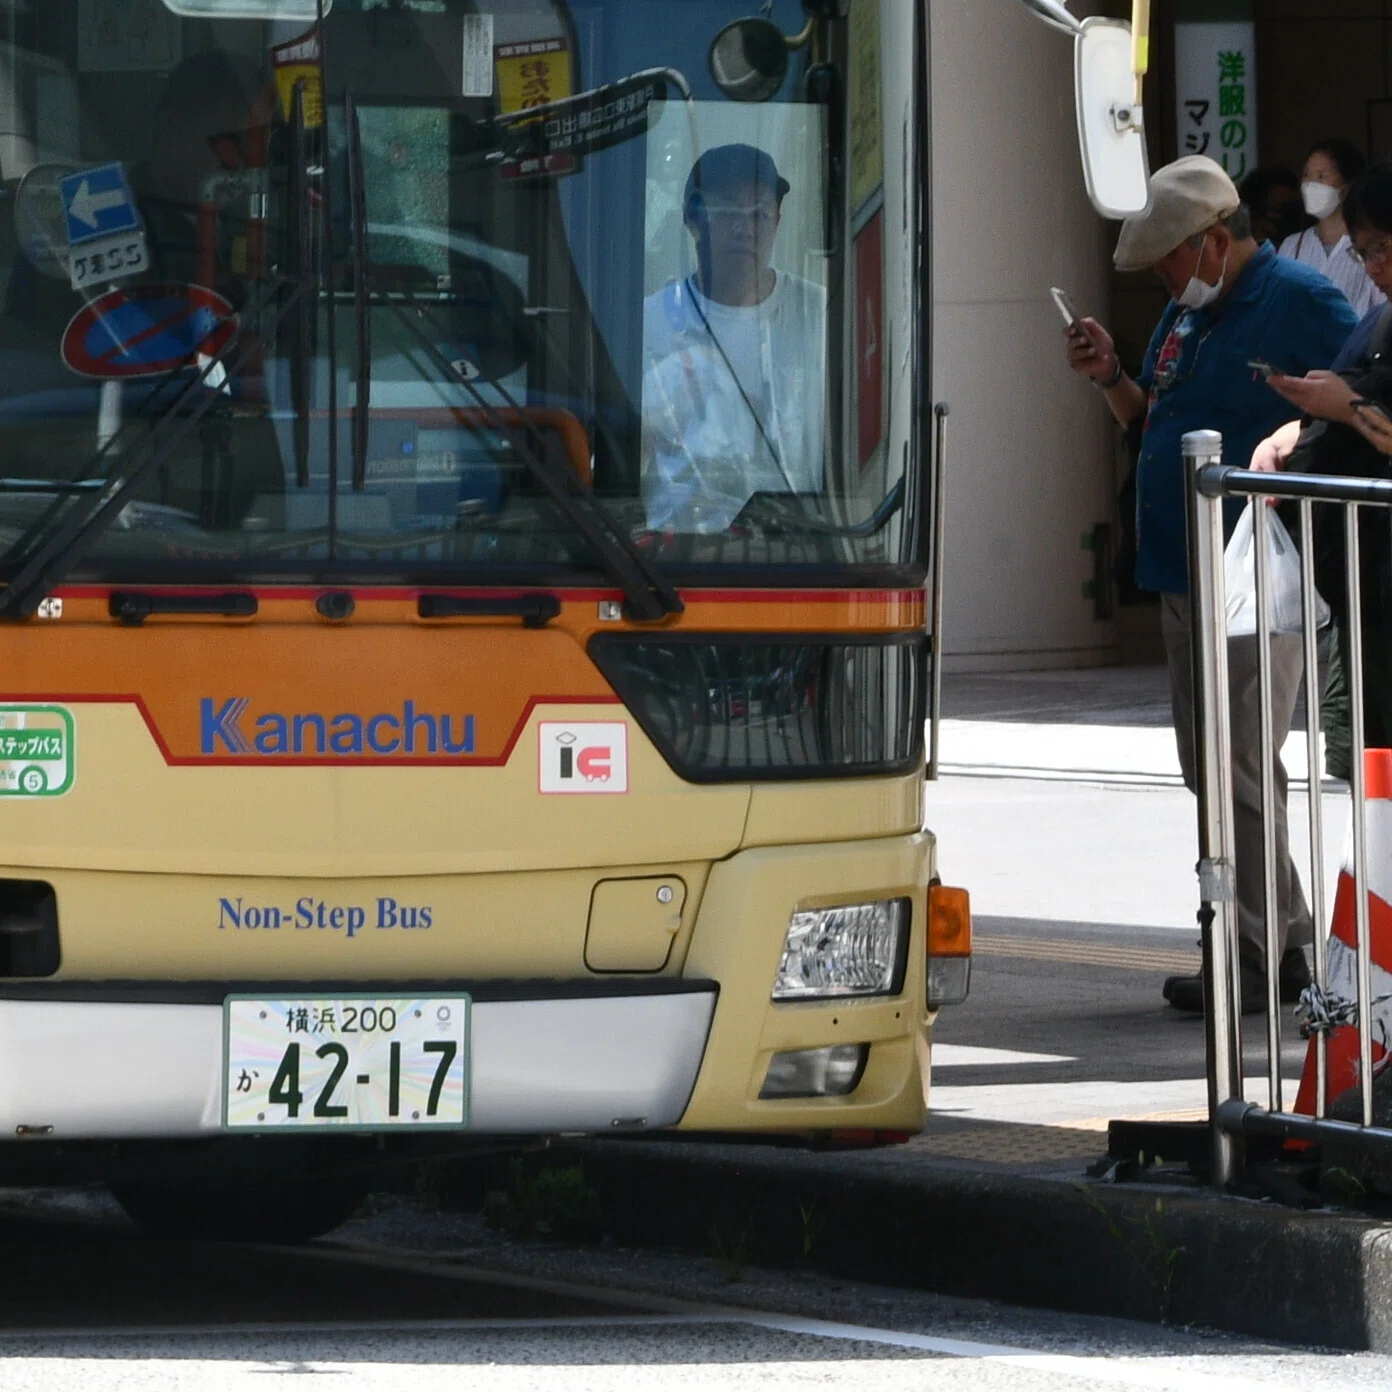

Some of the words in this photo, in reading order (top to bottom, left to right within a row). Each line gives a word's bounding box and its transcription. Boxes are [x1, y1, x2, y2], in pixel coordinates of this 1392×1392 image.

[199, 696, 476, 755] Kanachu
[28, 774, 39, 789] 5
[217, 897, 366, 938] Non-Step
[375, 897, 434, 930] Bus
[236, 1068, 260, 1093] か
[268, 1040, 458, 1119] 42-17
